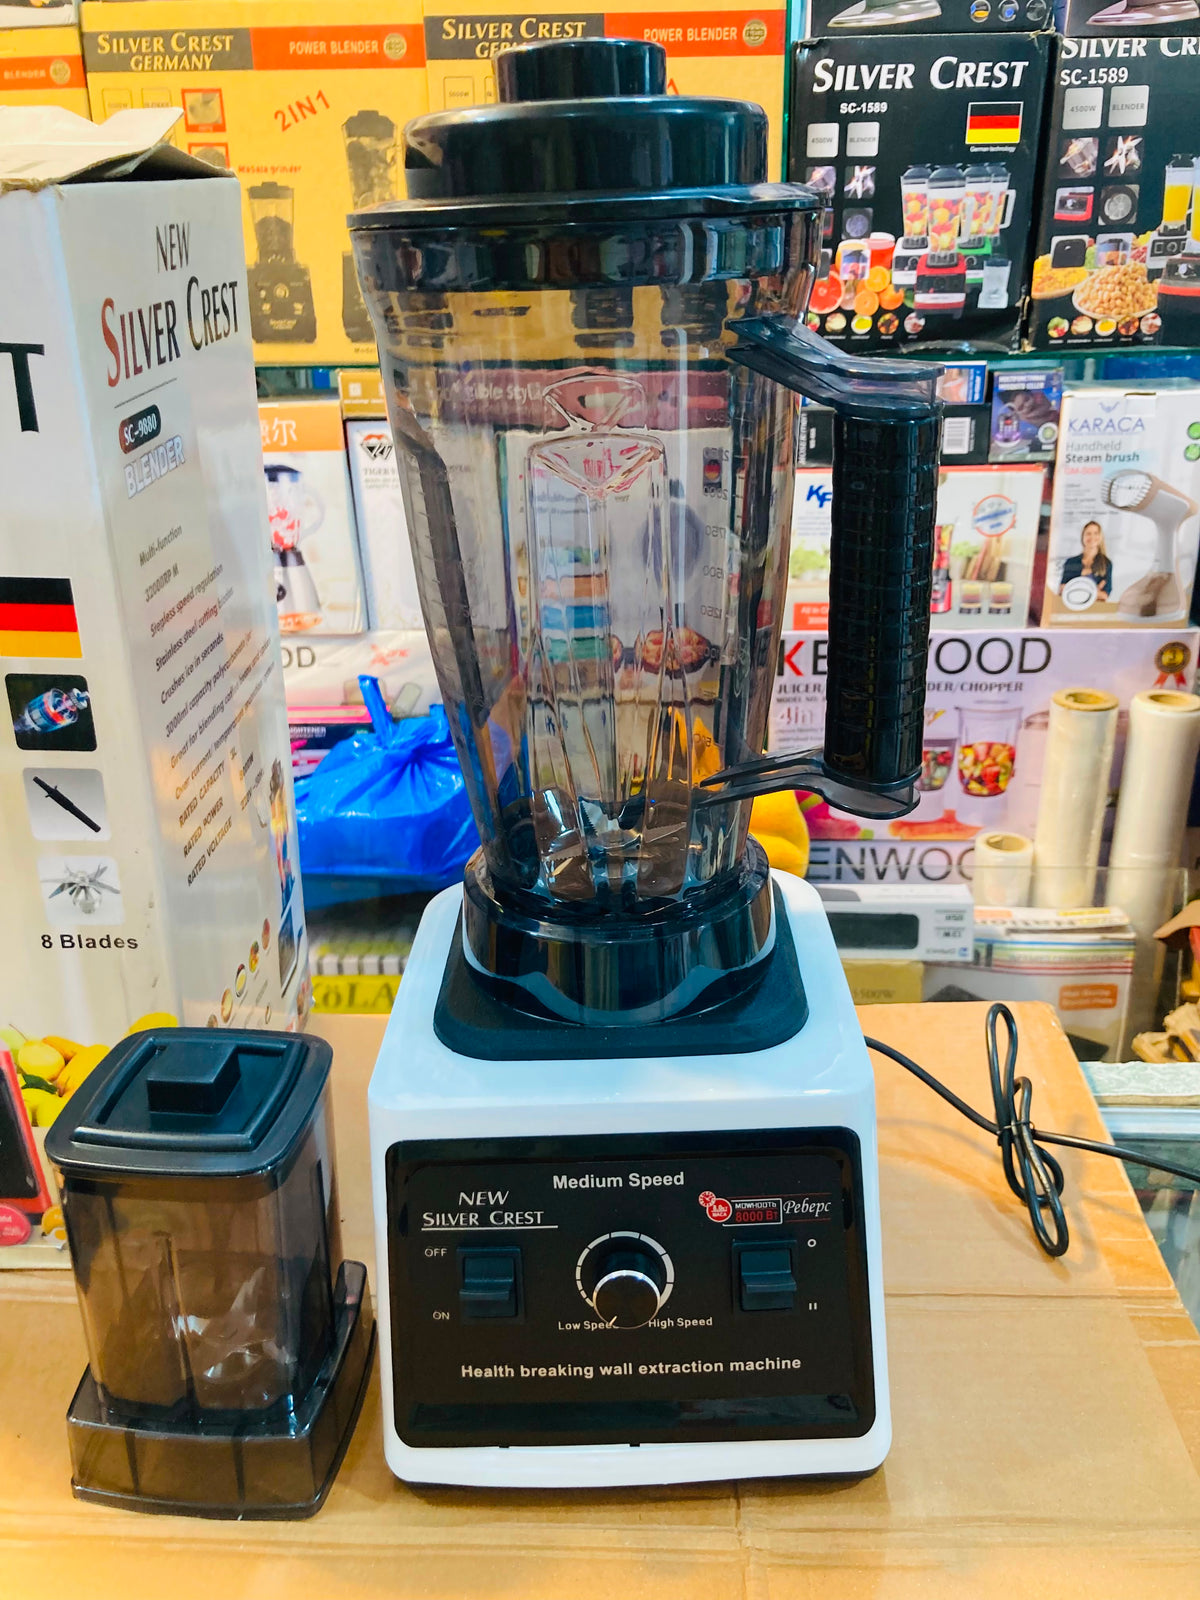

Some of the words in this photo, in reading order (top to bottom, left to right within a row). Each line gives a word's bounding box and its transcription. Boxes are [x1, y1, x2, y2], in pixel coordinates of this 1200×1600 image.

[442, 19, 514, 40] SILVER
[519, 17, 587, 39] CREST
[643, 28, 683, 42] POWER
[687, 27, 737, 41] BLENDER
[97, 32, 165, 54] SILVER
[171, 31, 234, 52] CREST
[289, 41, 327, 54] POWER
[330, 40, 379, 54] BLENDER
[1060, 37, 1148, 59] SILVER
[130, 54, 213, 71] GERMANY
[812, 58, 915, 93] SILVER
[929, 56, 1029, 89] CREST
[1060, 67, 1129, 86] SC-1589
[840, 102, 888, 114] SC-1589
[1112, 103, 1145, 111] BLENDER
[156, 222, 190, 273] NEW
[101, 297, 181, 388] SILVER
[186, 276, 239, 351] CREST
[123, 413, 158, 446] SC-9880
[1068, 416, 1146, 432] KARACA
[1066, 441, 1122, 452] Handheld
[1065, 453, 1102, 463] Steam
[1105, 452, 1140, 463] brush
[123, 435, 186, 500] BLENDER
[179, 797, 198, 828] RATED
[199, 760, 225, 800] CAPACITY
[183, 826, 202, 858] RATED
[203, 796, 224, 830] POWER
[187, 854, 206, 887] RATED
[206, 815, 232, 857] VOLTAGE
[41, 934, 52, 950] 8
[61, 933, 139, 950] Blades
[552, 1174, 623, 1189] Medium
[628, 1171, 685, 1190] Speed
[458, 1190, 510, 1206] NEW
[422, 1212, 479, 1227] SILVER
[489, 1210, 545, 1225] CREST
[735, 1211, 763, 1223] 8000
[424, 1248, 448, 1257] OFF
[432, 1310, 450, 1321] ON
[648, 1317, 674, 1329] High
[677, 1316, 713, 1328] Speed
[558, 1320, 581, 1331] Low
[461, 1364, 515, 1378] Health
[520, 1363, 594, 1379] breaking
[599, 1362, 633, 1375] wall
[638, 1360, 724, 1374] extraction
[729, 1356, 802, 1371] machine
